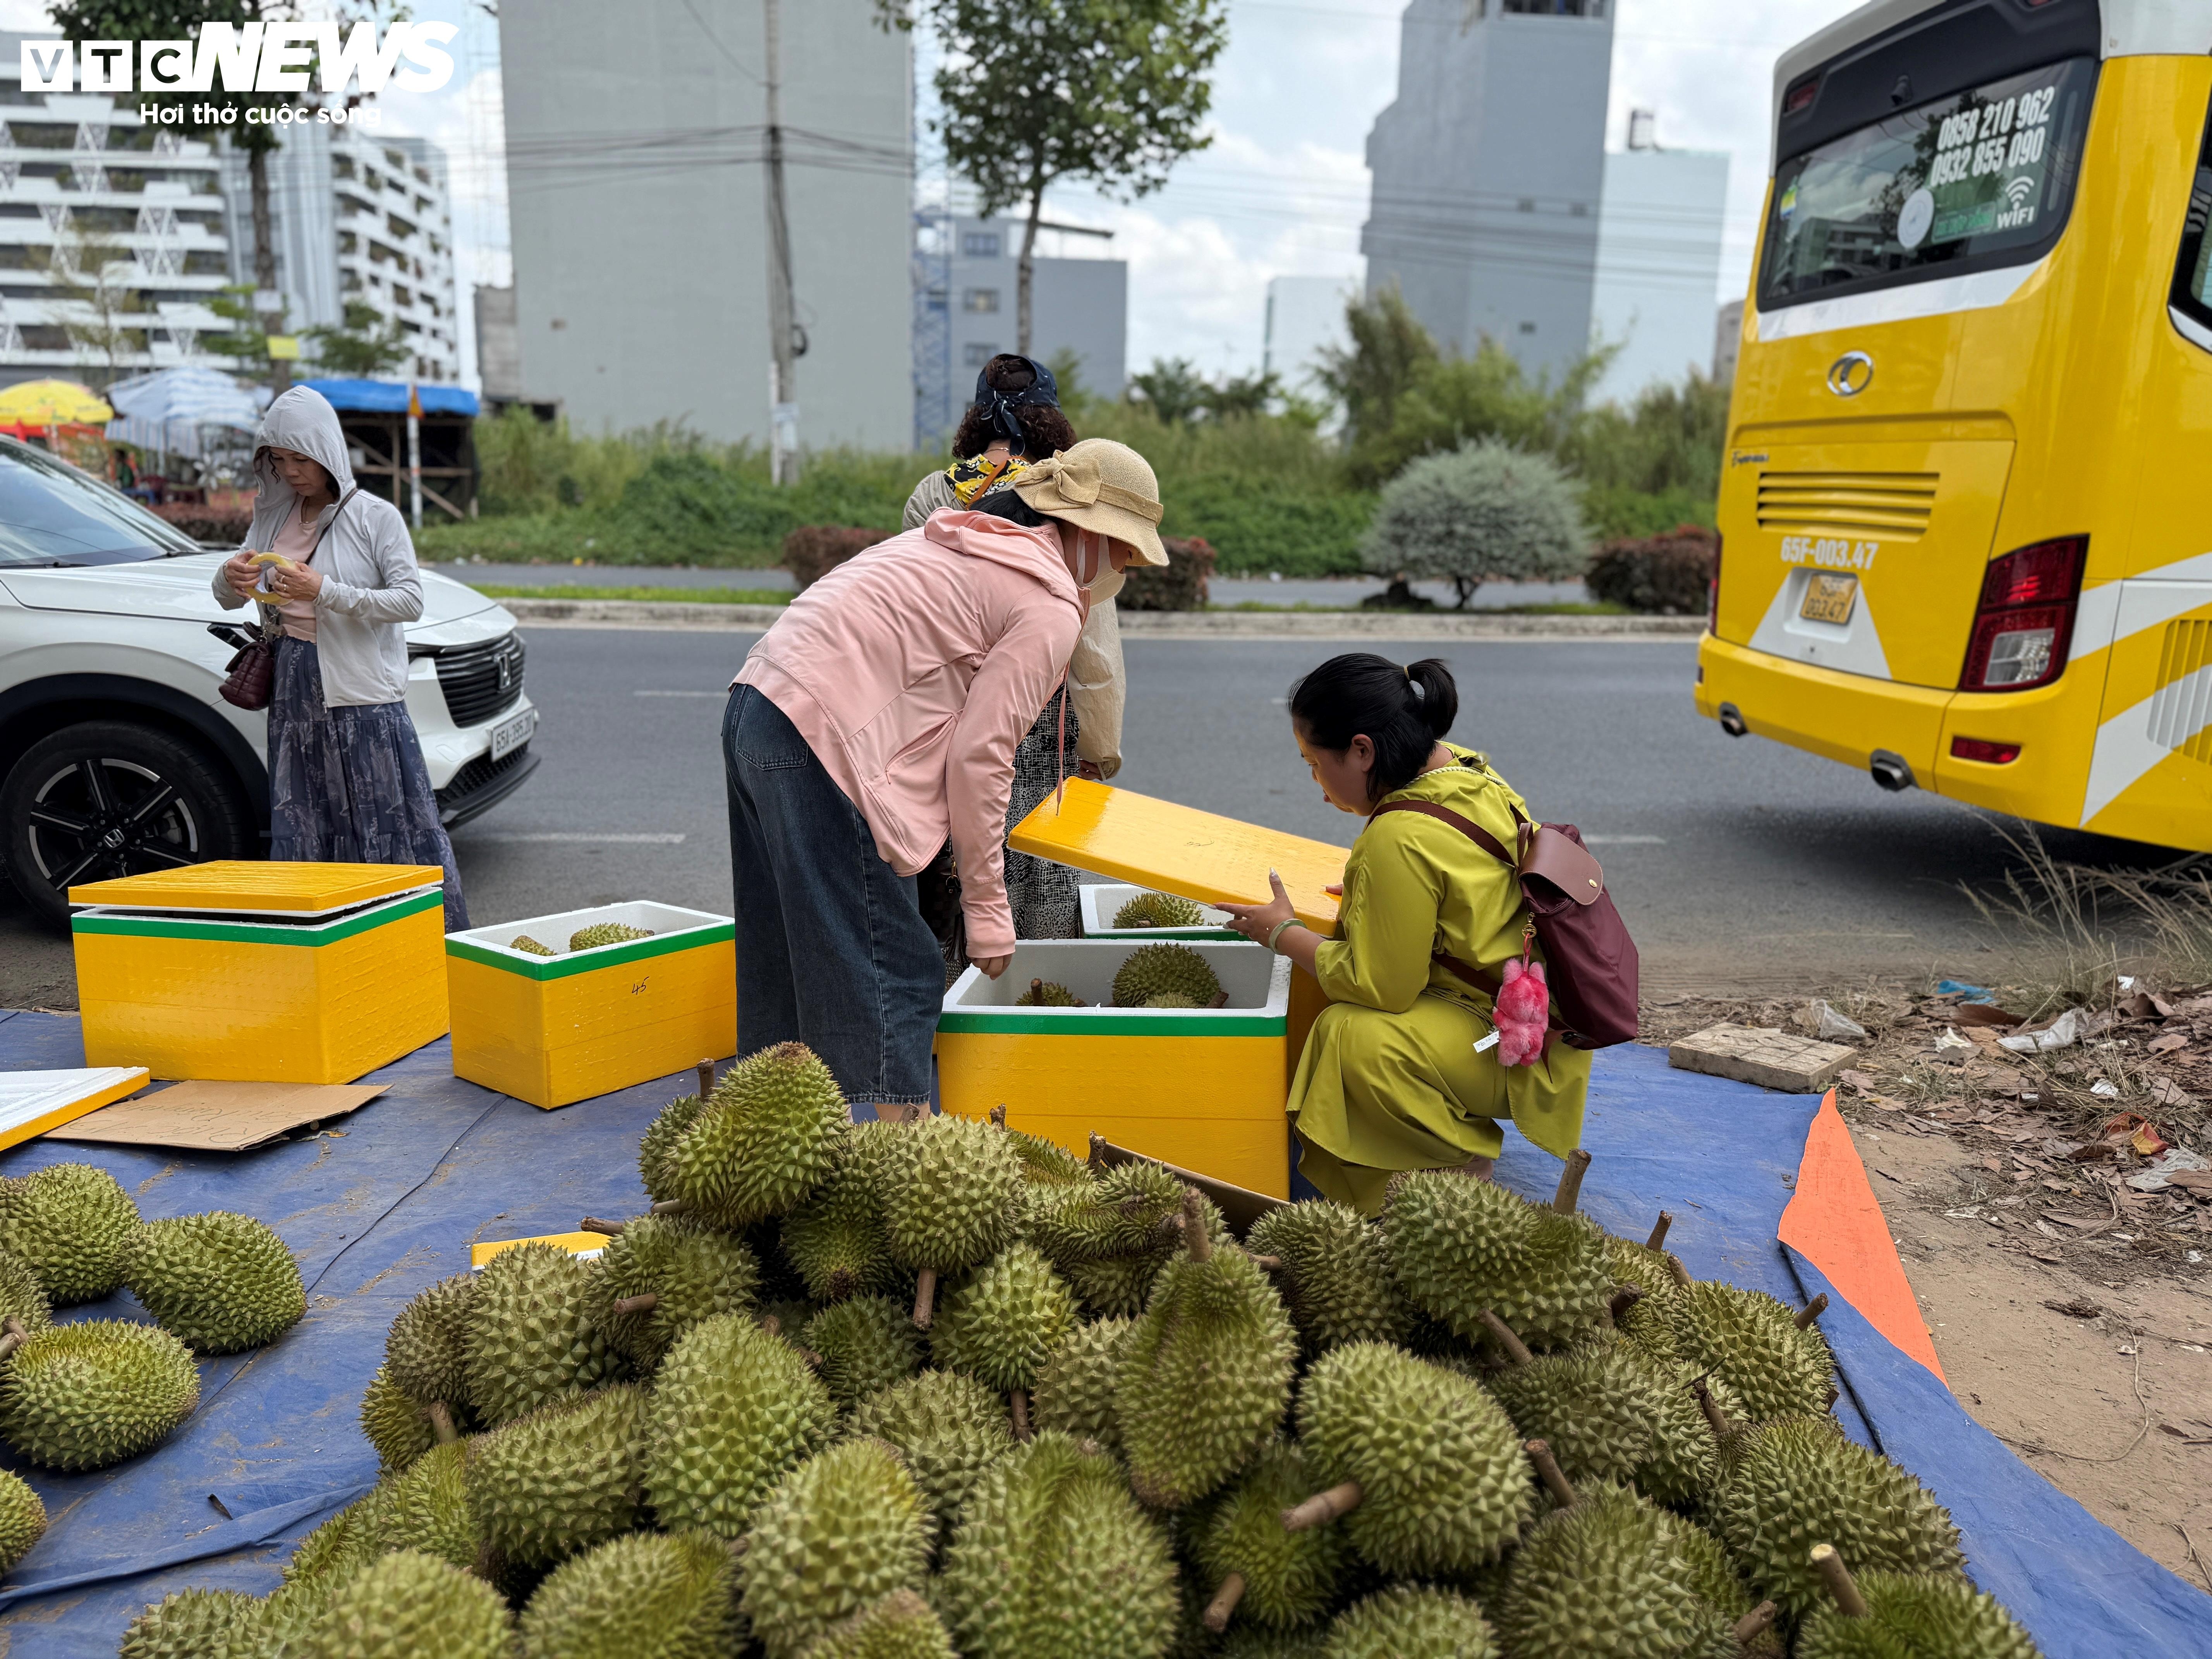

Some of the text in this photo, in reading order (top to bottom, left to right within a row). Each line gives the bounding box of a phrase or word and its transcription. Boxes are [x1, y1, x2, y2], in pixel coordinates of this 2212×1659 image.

[1937, 86, 2055, 151] 0858 210 962
[1930, 126, 2045, 187] 0932 855 090
[1781, 536, 1879, 570] 65F-003.47
[632, 976, 649, 995] 45
